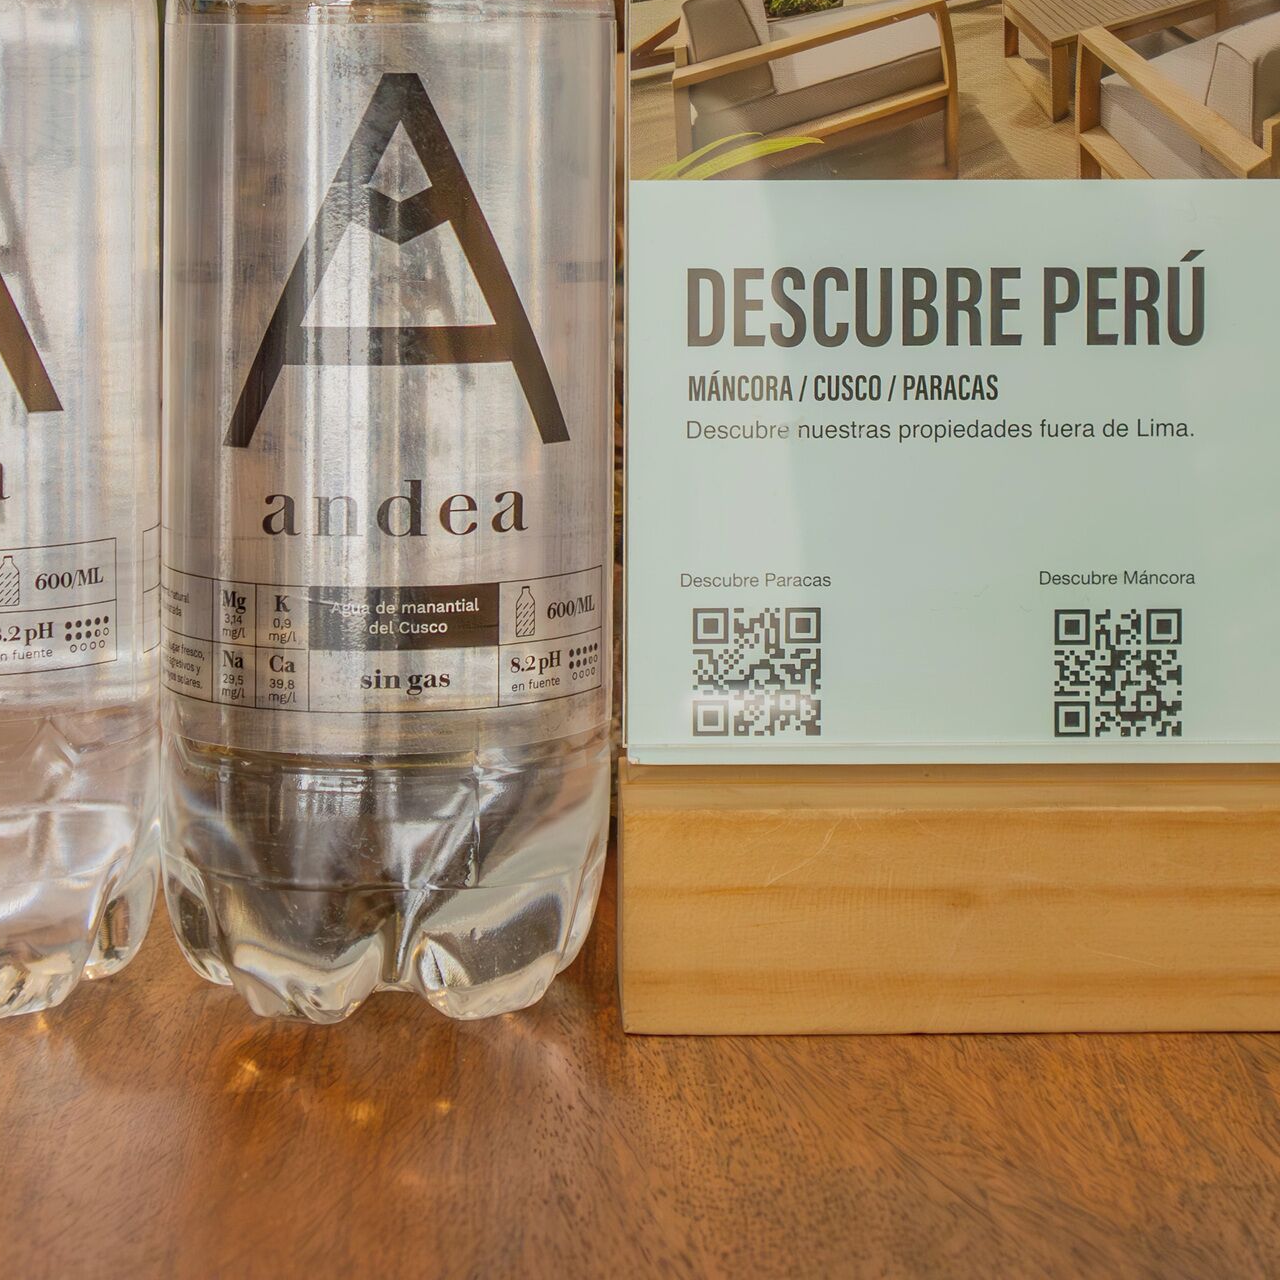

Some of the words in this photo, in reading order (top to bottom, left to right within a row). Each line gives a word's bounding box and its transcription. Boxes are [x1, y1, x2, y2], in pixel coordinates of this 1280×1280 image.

[686, 266, 1023, 348] DESCUBRE
[1041, 249, 1206, 348] PERÚ
[688, 370, 793, 401] MÁNCORA
[813, 374, 882, 401] CUSCO
[903, 373, 1000, 401] PARACAS
[686, 420, 790, 439] Descubre
[798, 421, 891, 439] nuestras
[899, 419, 1033, 443] propiedades
[1040, 419, 1095, 438] fuera
[1102, 418, 1129, 438] de
[1137, 418, 1195, 437] Lima.
[262, 479, 529, 538] andea
[35, 567, 104, 590] 600/ML
[680, 573, 759, 588] Descubre
[765, 573, 832, 587] Paracas
[1039, 570, 1118, 585] Descubre
[1123, 570, 1195, 585] Máncora
[222, 590, 247, 615] Mg
[274, 595, 291, 612] K
[331, 603, 370, 617] Agua
[375, 601, 395, 614] de
[401, 598, 480, 614] manantial
[547, 595, 595, 620] 600/ML
[224, 613, 242, 625] 3,14
[273, 618, 292, 630] 0,9
[25, 621, 54, 646] pH
[222, 627, 245, 640] mg/l
[369, 621, 394, 635] del
[399, 622, 448, 634] Cusco
[268, 631, 297, 644] mg/l
[12, 648, 53, 661] fuente
[222, 650, 244, 669] Na
[510, 655, 535, 673] 8.2
[538, 650, 562, 675] pH
[269, 655, 296, 673] Ca
[223, 674, 244, 686] 29,5
[269, 678, 295, 690] 39,8
[360, 669, 400, 689] sin
[406, 672, 451, 696] gas
[512, 682, 525, 692] en
[528, 677, 560, 689] fuente
[222, 687, 245, 700] mg/l
[268, 692, 297, 704] mg/l
